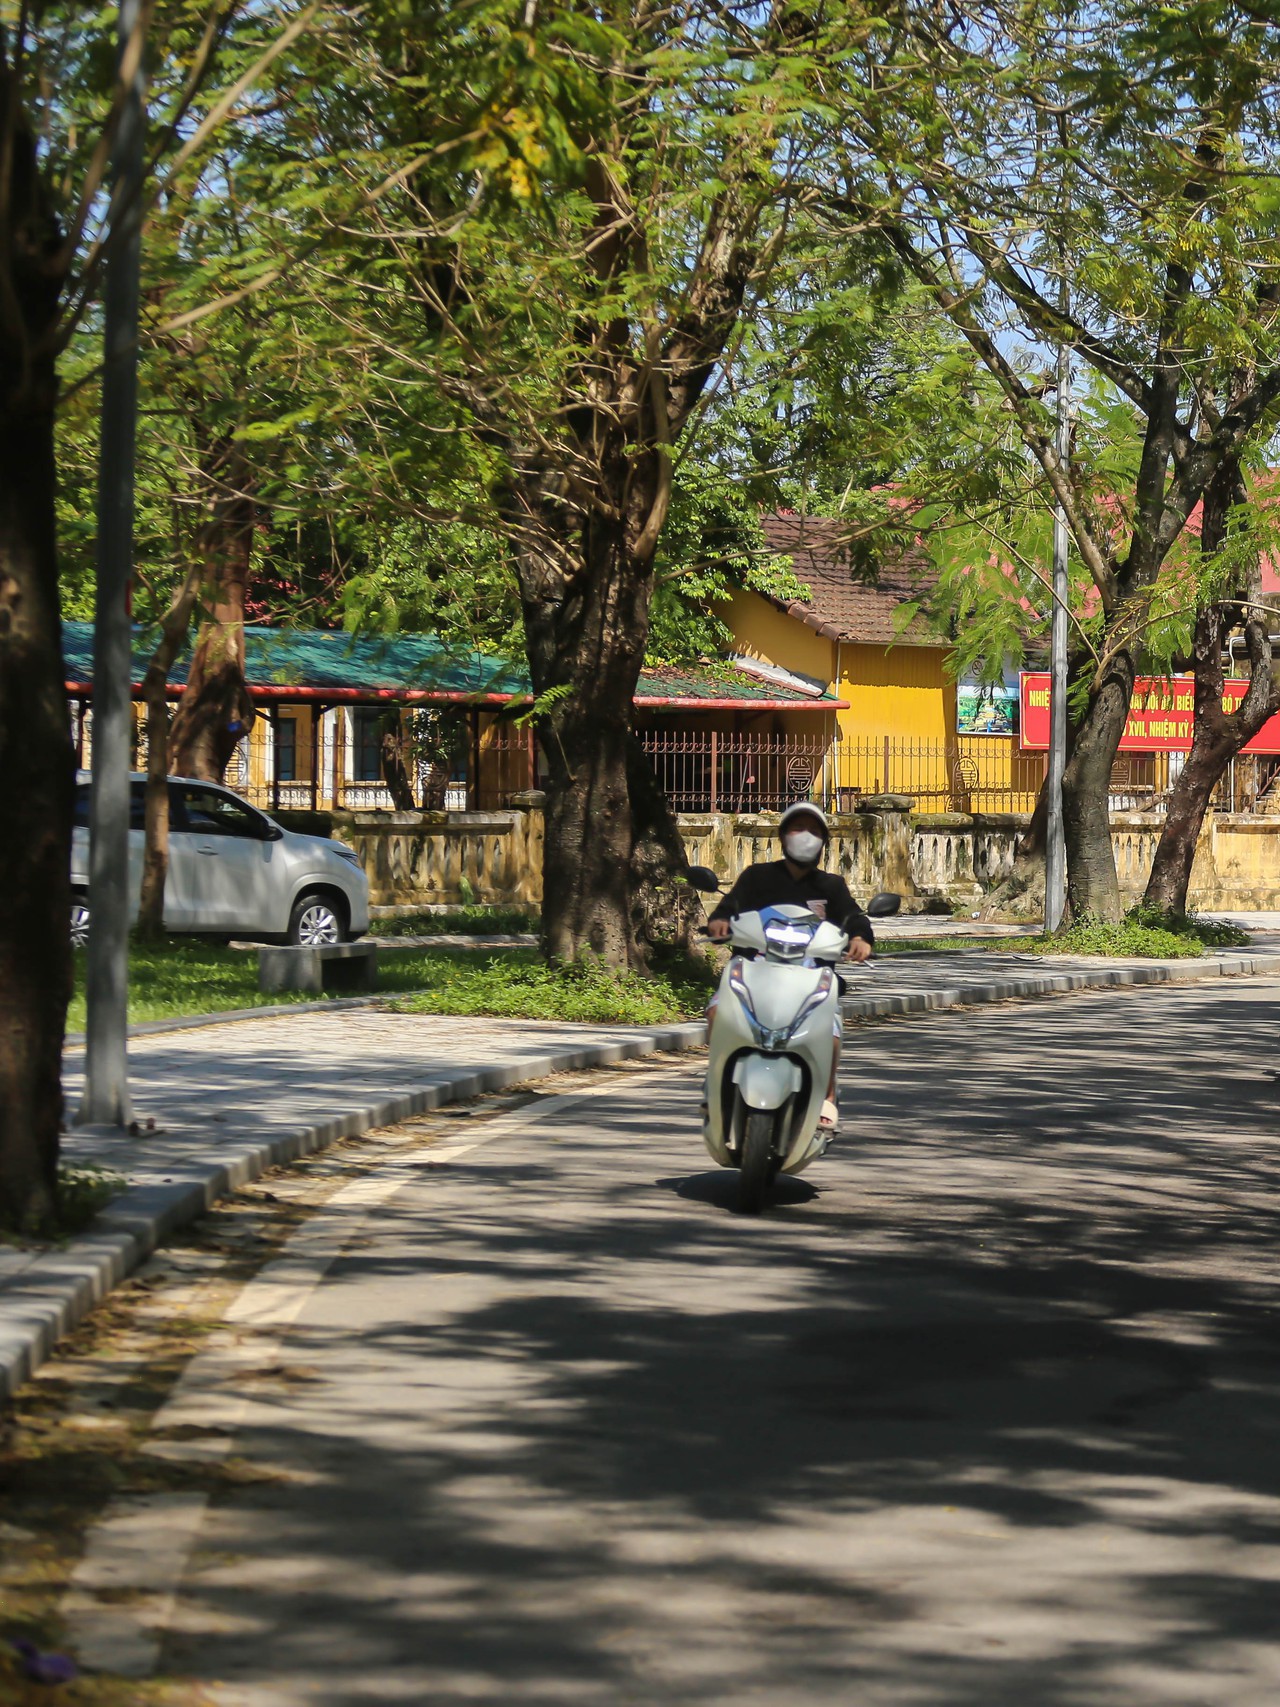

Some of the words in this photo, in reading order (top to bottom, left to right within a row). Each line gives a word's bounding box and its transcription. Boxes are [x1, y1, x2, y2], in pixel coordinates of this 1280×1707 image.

[1029, 687, 1051, 711] NHIỆ
[1128, 720, 1147, 739] XVII,
[1149, 718, 1176, 741] NHIỆM
[1178, 719, 1189, 738] KỲ
